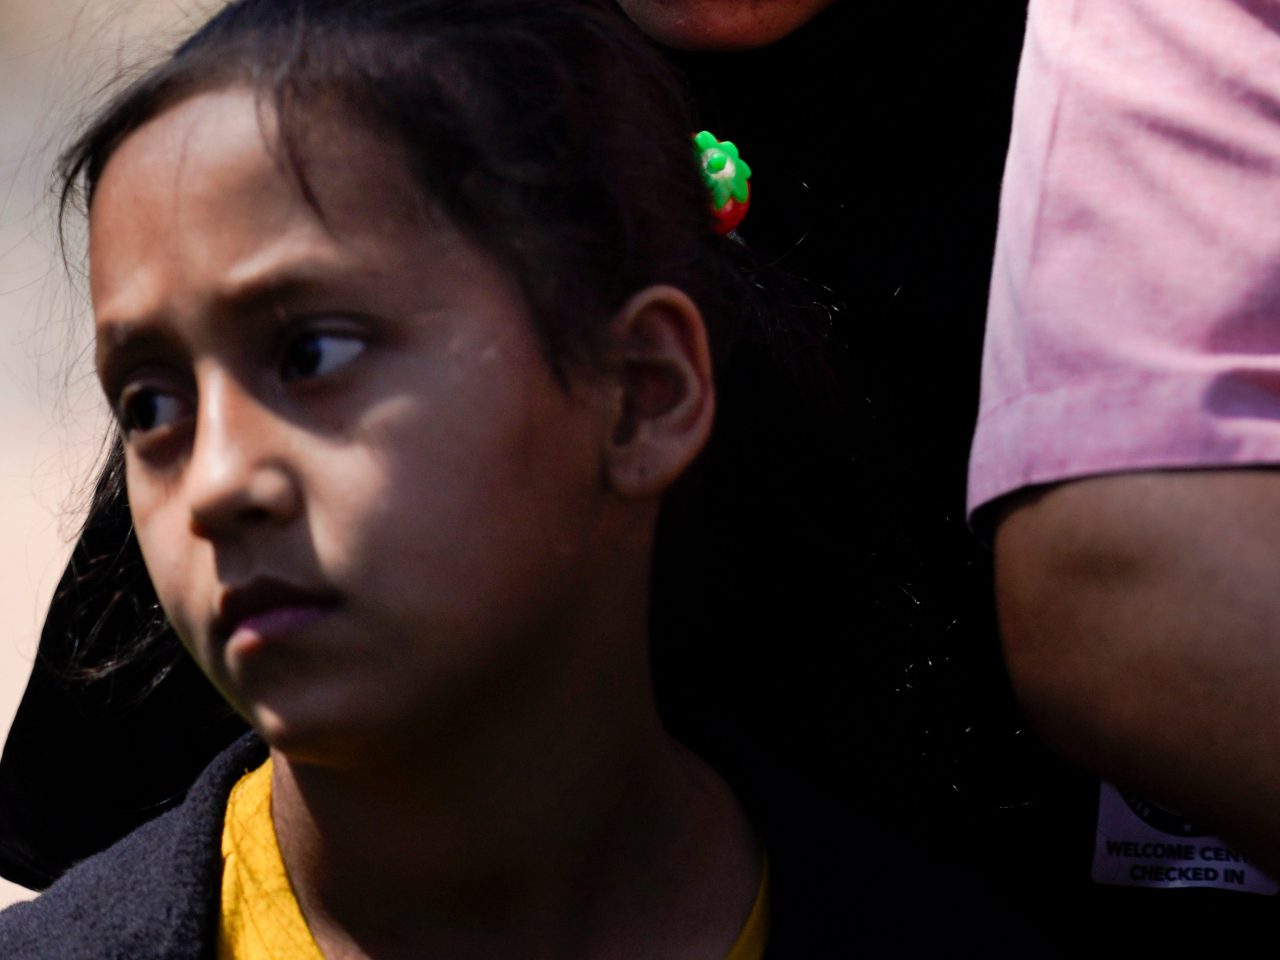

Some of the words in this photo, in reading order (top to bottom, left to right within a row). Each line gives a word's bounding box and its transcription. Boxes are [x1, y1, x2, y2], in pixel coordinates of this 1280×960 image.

[1106, 841, 1195, 860] WELCOME
[1130, 865, 1218, 881] CHECKED
[1224, 868, 1245, 884] IN
